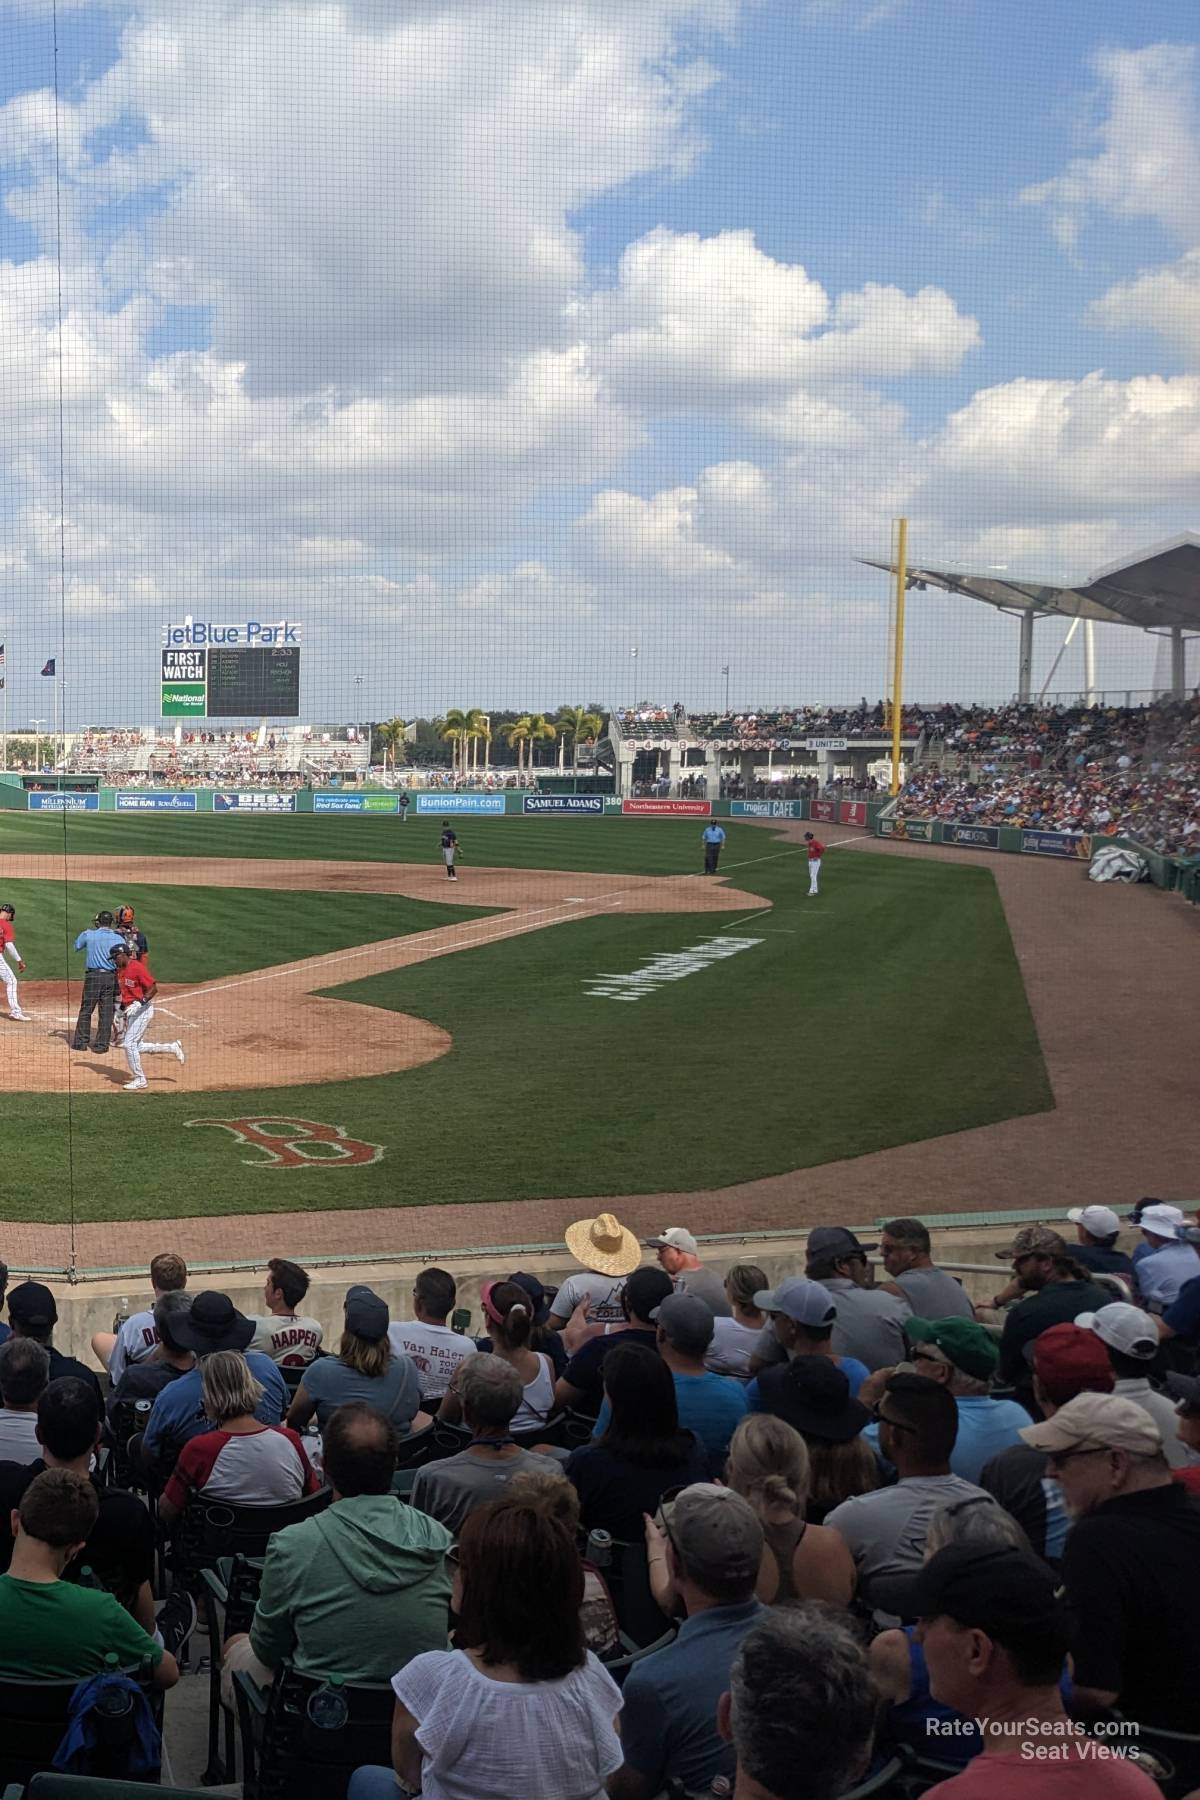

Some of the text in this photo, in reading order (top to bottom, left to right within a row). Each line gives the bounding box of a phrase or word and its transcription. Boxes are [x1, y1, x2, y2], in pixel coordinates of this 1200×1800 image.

[166, 621, 297, 648] jetBlue Park
[167, 652, 201, 665] FIRST
[164, 666, 203, 679] WATCH
[172, 694, 204, 702] National
[698, 741, 710, 749] 27
[780, 741, 790, 749] 42
[815, 740, 845, 748] UNITED
[238, 795, 292, 803] BEST
[420, 798, 501, 807] BunionPain.com
[526, 797, 601, 809] SAMUEL ADAMS
[605, 797, 622, 805] 380
[630, 803, 705, 812] Northeastern University
[743, 802, 770, 813] tropical
[182, 1116, 387, 1168] B
[270, 1328, 317, 1350] HARPER
[403, 1341, 465, 1361] Van Halen
